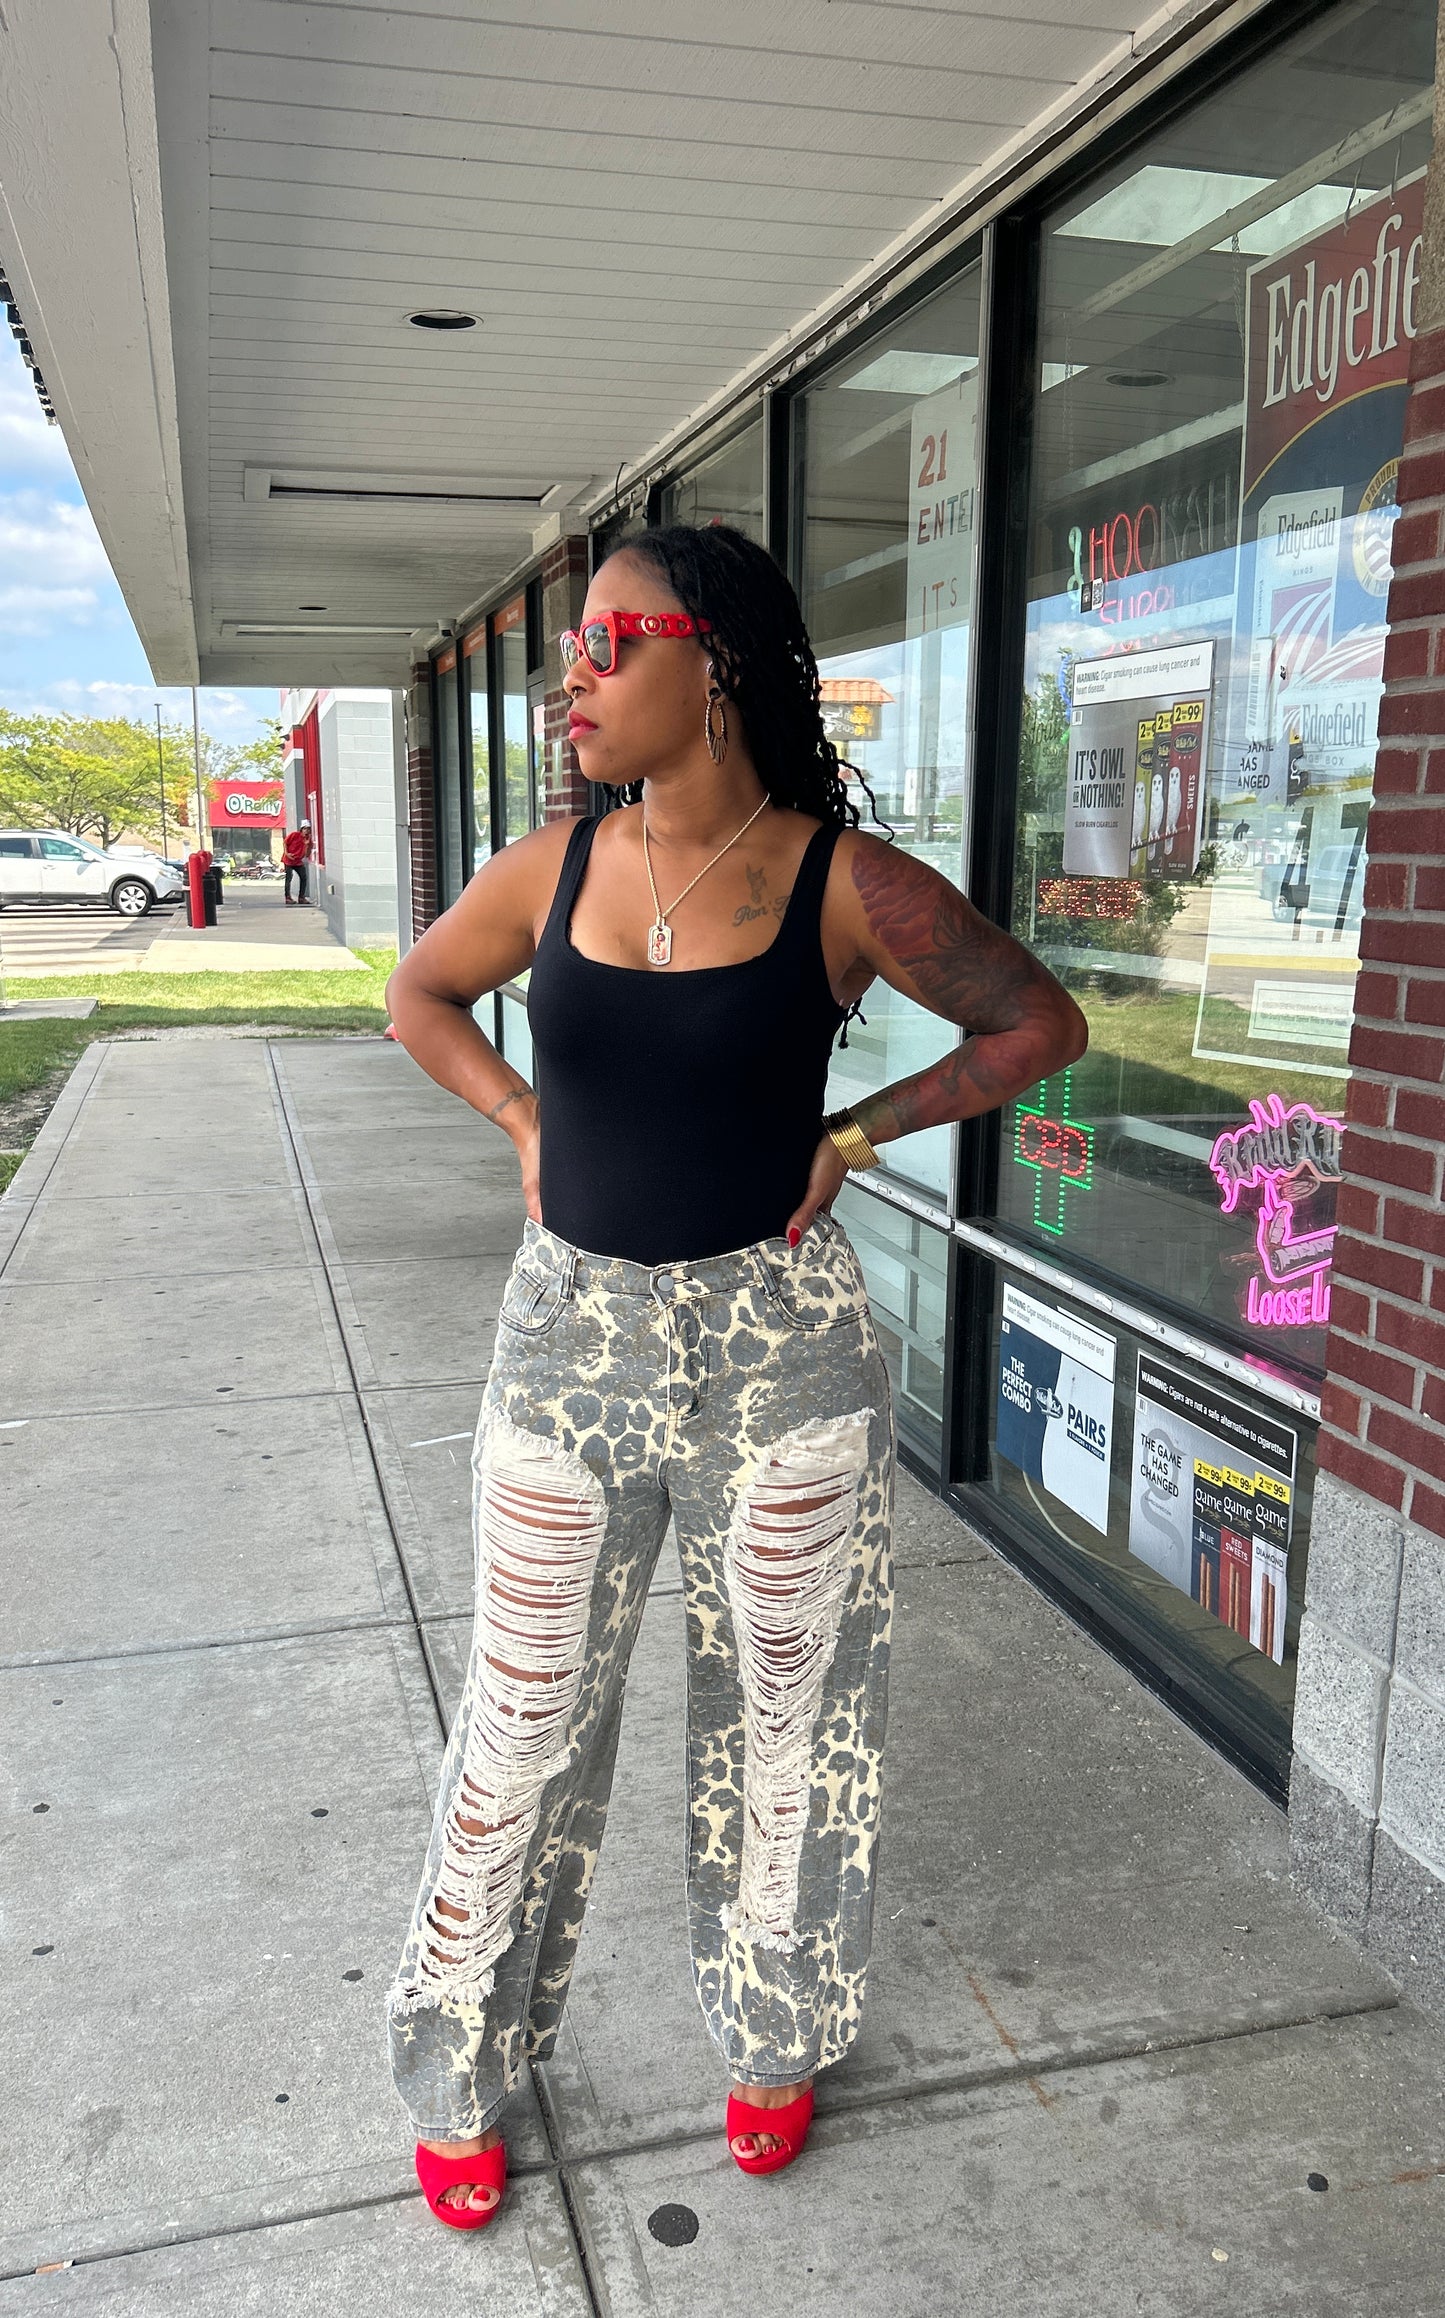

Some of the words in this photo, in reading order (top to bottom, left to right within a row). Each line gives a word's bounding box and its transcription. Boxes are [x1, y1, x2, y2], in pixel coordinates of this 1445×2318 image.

[918, 429, 948, 488] 21
[1276, 507, 1337, 559] Edgefield
[1076, 671, 1100, 684] WARNING:
[1101, 669, 1113, 682] Cigar
[1113, 666, 1133, 679] smoking
[1133, 666, 1143, 675] can
[1143, 664, 1158, 674] cause
[1159, 661, 1170, 673] lung
[1171, 658, 1189, 669] cancer
[1190, 656, 1200, 667] and
[1302, 702, 1367, 750] Edgefield
[1074, 750, 1097, 780] IT'S
[1100, 747, 1126, 780] OWL
[1325, 754, 1345, 766] BOX
[1080, 782, 1125, 808] NOTHING!
[1187, 774, 1196, 810] SWEETS
[1036, 1310, 1052, 1328] smoking
[1052, 1320, 1060, 1331] can
[1059, 1323, 1072, 1338] cause
[1081, 1334, 1096, 1352] cancer
[1010, 1355, 1025, 1374] THE
[1002, 1367, 1033, 1397] PERFECT
[1001, 1382, 1032, 1413] COMBO
[1067, 1402, 1106, 1448] PAIRS
[1141, 1370, 1168, 1393] WARNING:
[1168, 1385, 1185, 1404] Cigars
[1185, 1394, 1194, 1409] are
[1194, 1398, 1203, 1413] not
[1203, 1406, 1208, 1415] a
[1207, 1408, 1220, 1422] safe
[1220, 1414, 1250, 1438] alternative
[1250, 1429, 1257, 1442] to
[1257, 1434, 1288, 1459] cigarettes.
[1140, 1433, 1156, 1452] THE
[1157, 1442, 1182, 1470] GAME
[1151, 1456, 1168, 1476] HAS
[1197, 1463, 1202, 1474] 2
[1226, 1471, 1231, 1482] 2
[1140, 1464, 1179, 1498] CHANGED
[1258, 1476, 1264, 1488] 2
[1195, 1488, 1222, 1513] game
[1223, 1496, 1252, 1522] game
[1255, 1503, 1287, 1530] game
[1225, 1542, 1249, 1561] SWEETS
[1231, 1536, 1243, 1549] RED
[1255, 1545, 1284, 1569] DIAMOND
